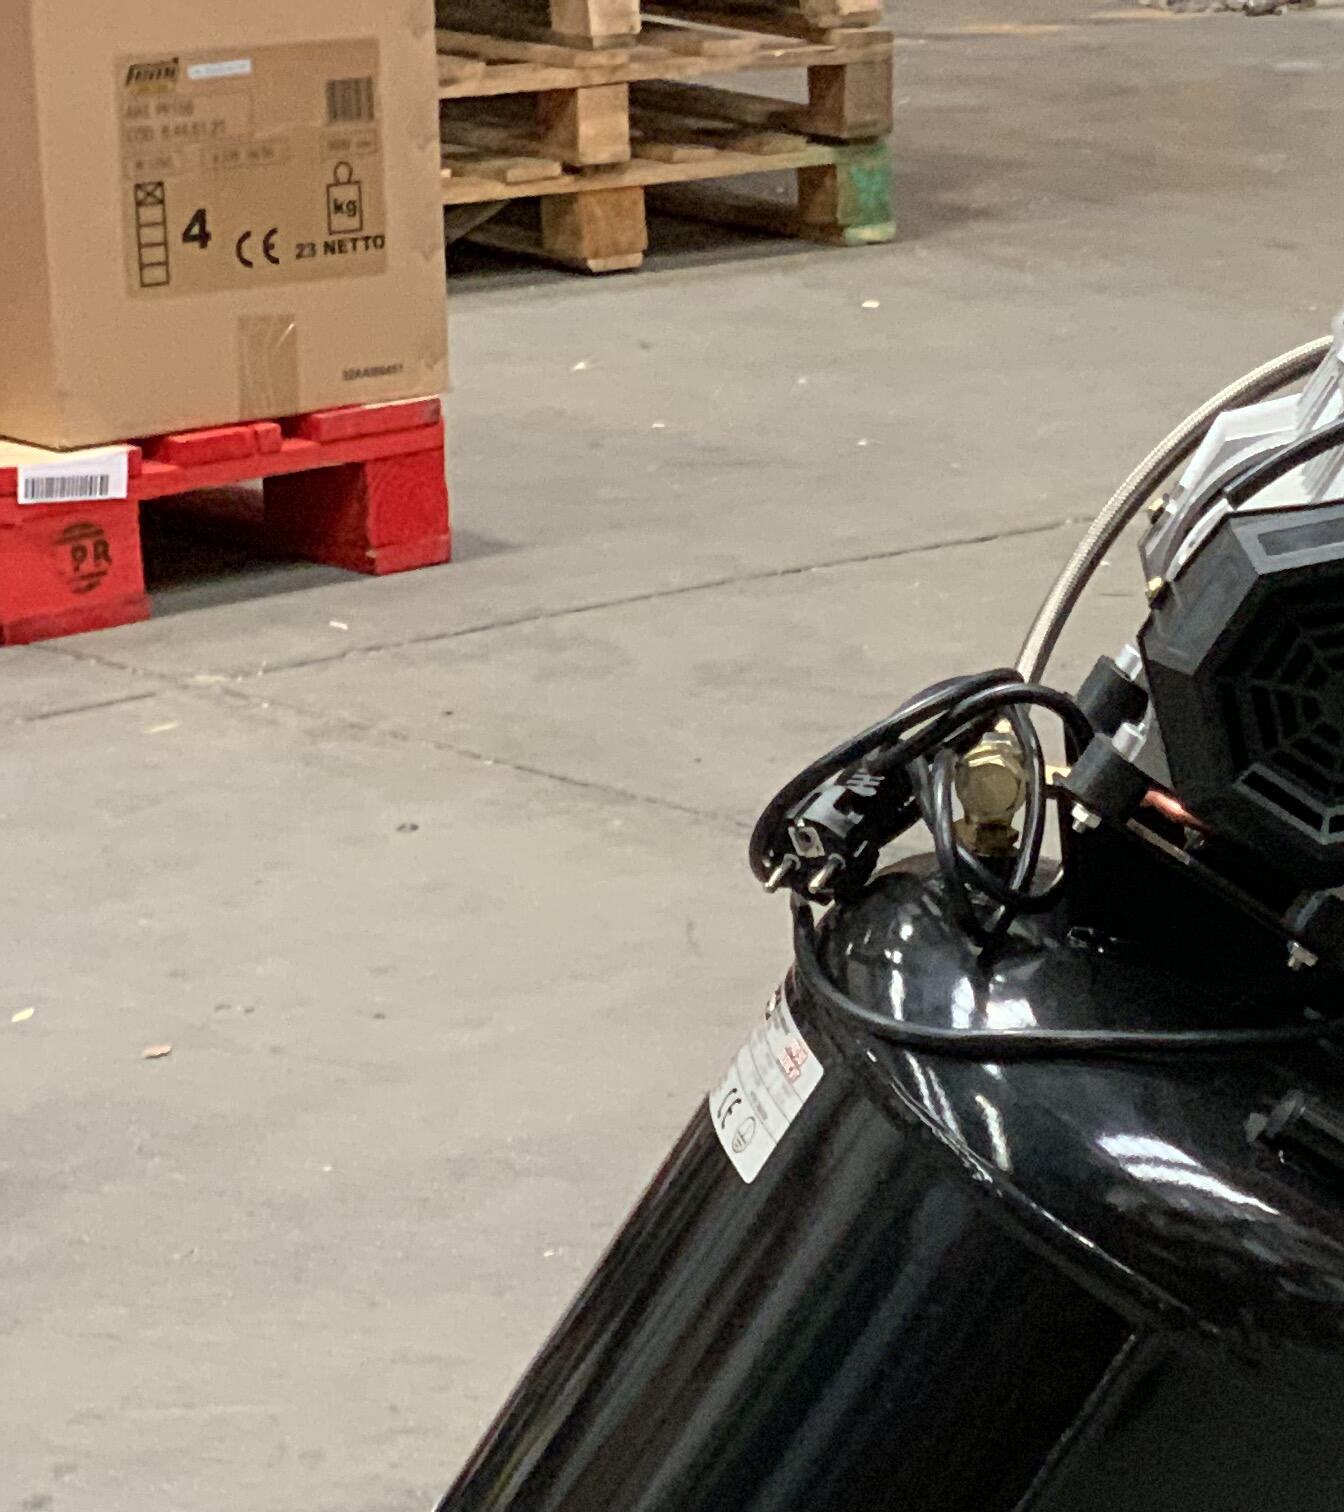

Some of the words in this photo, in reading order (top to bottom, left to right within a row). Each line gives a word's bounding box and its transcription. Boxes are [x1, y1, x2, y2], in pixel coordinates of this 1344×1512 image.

[332, 197, 358, 218] kg
[181, 207, 212, 249] 4
[295, 241, 318, 261] 23
[322, 234, 386, 256] NETTO
